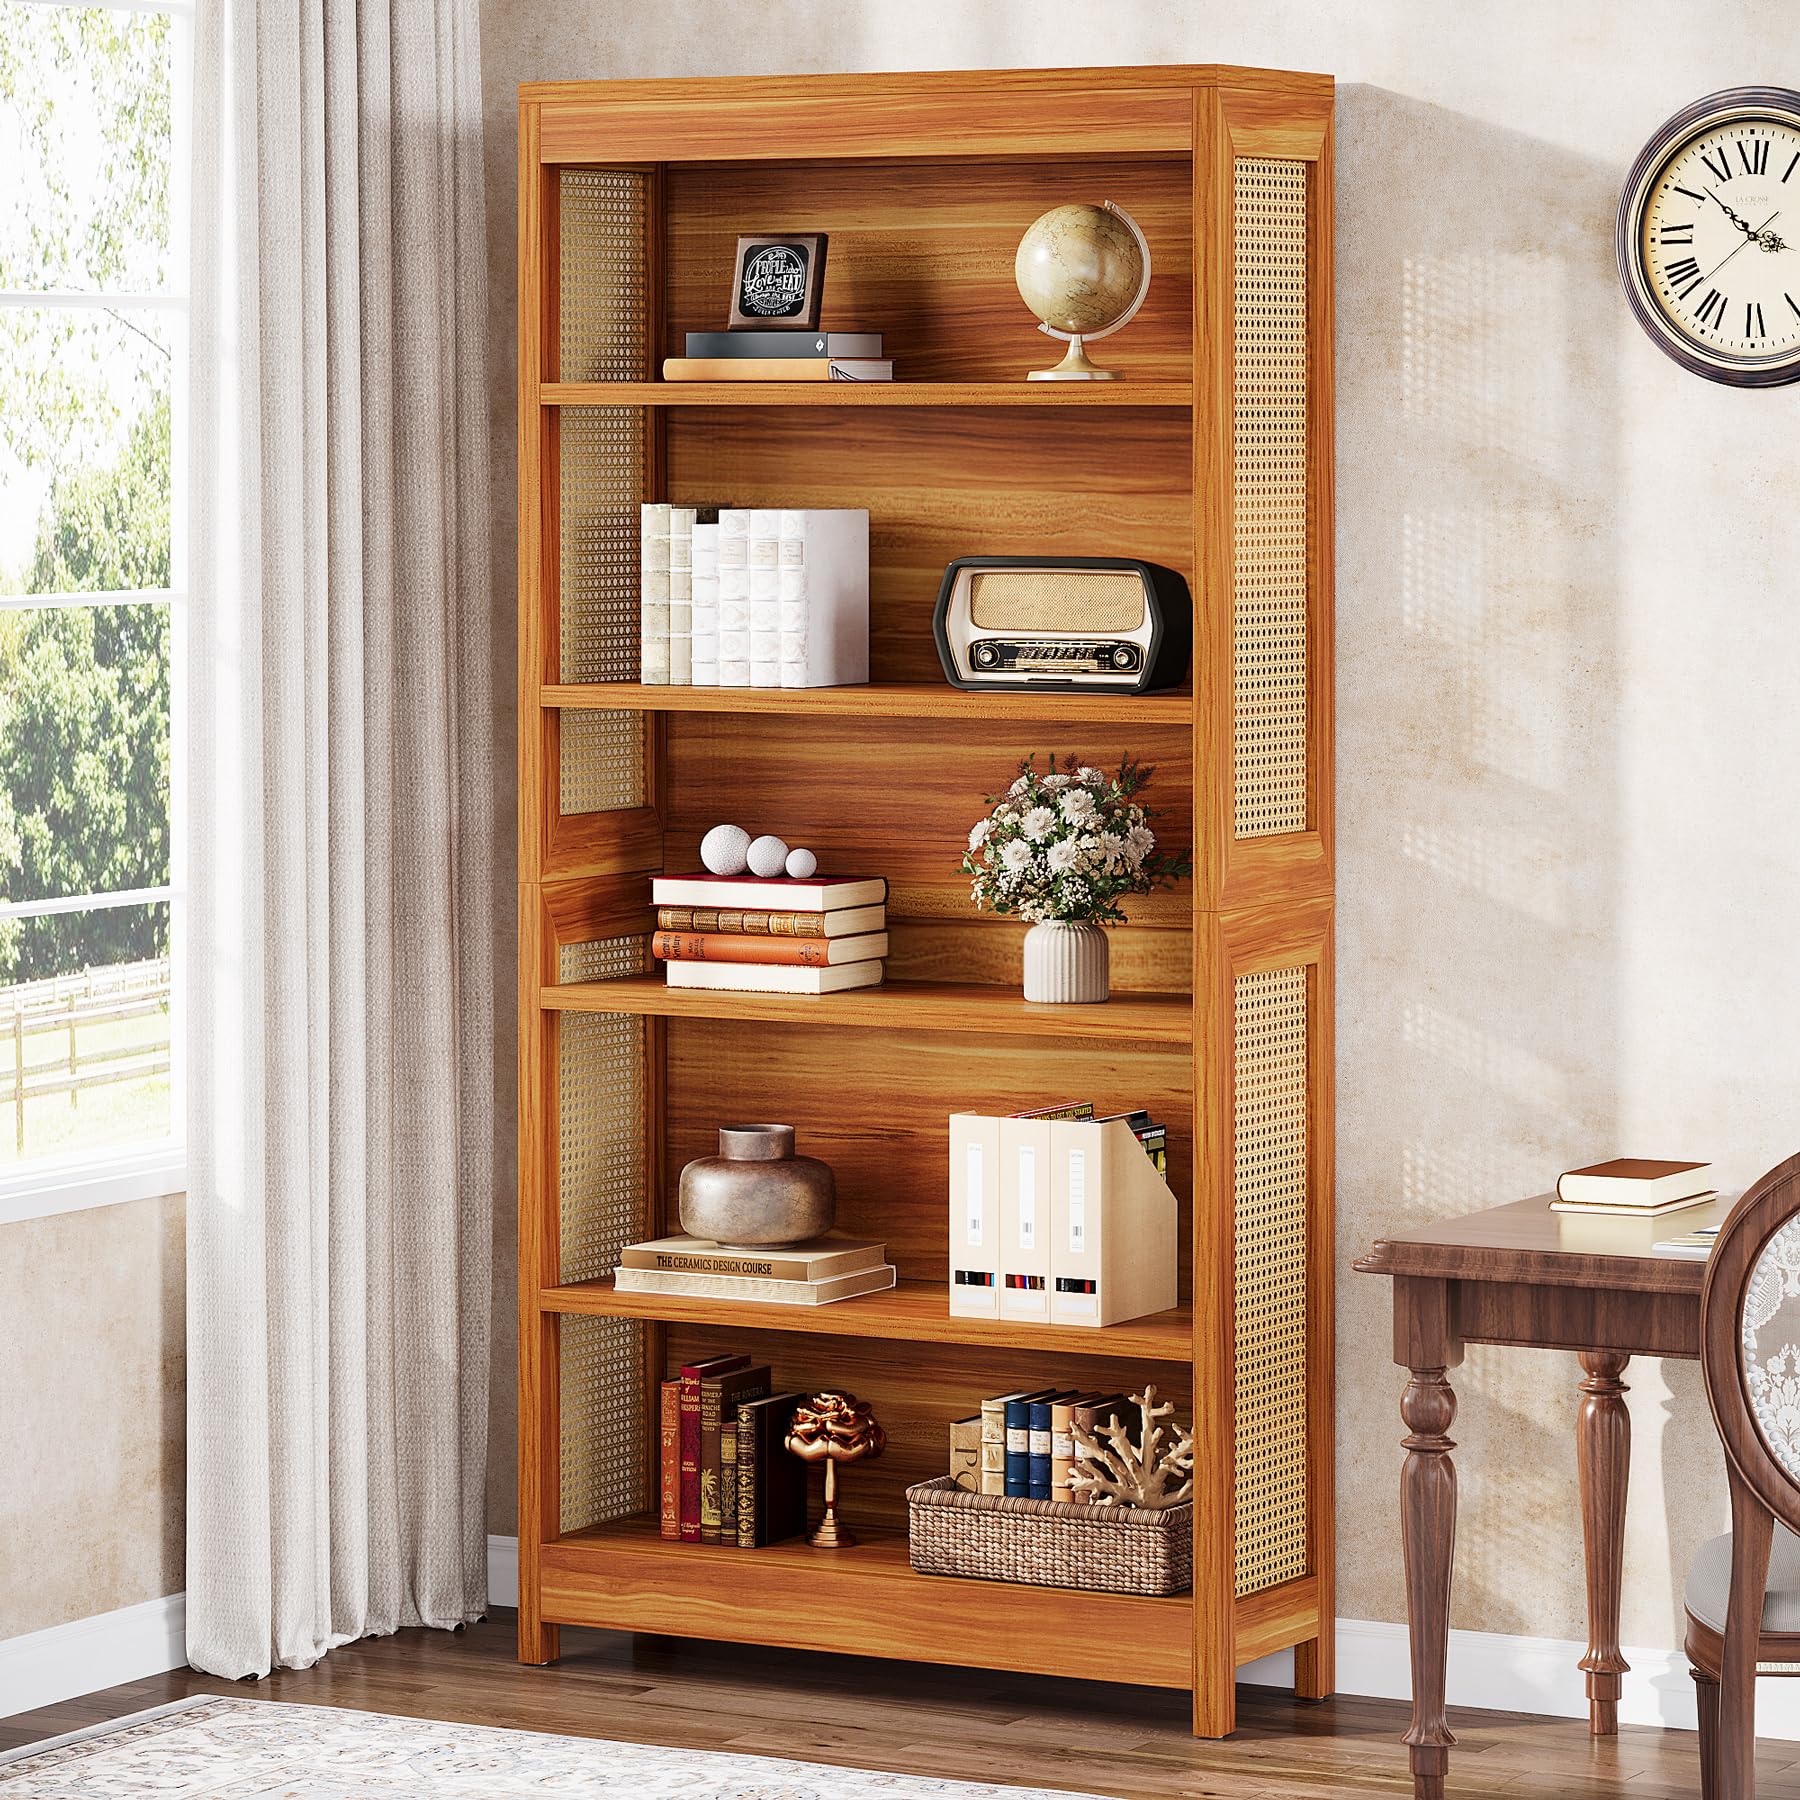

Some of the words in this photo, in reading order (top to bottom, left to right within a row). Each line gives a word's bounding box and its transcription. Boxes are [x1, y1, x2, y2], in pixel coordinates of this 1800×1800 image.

[1700, 146, 1733, 188] XI
[1736, 139, 1770, 176] XII
[1660, 219, 1694, 245] IX
[782, 274, 802, 291] EAT
[1664, 256, 1705, 301] VIII
[1693, 288, 1729, 331] VII
[656, 1255, 673, 1268] THE
[673, 1256, 712, 1271] CERAMICS
[713, 1260, 741, 1273] DESIGN
[742, 1261, 773, 1275] COURSE
